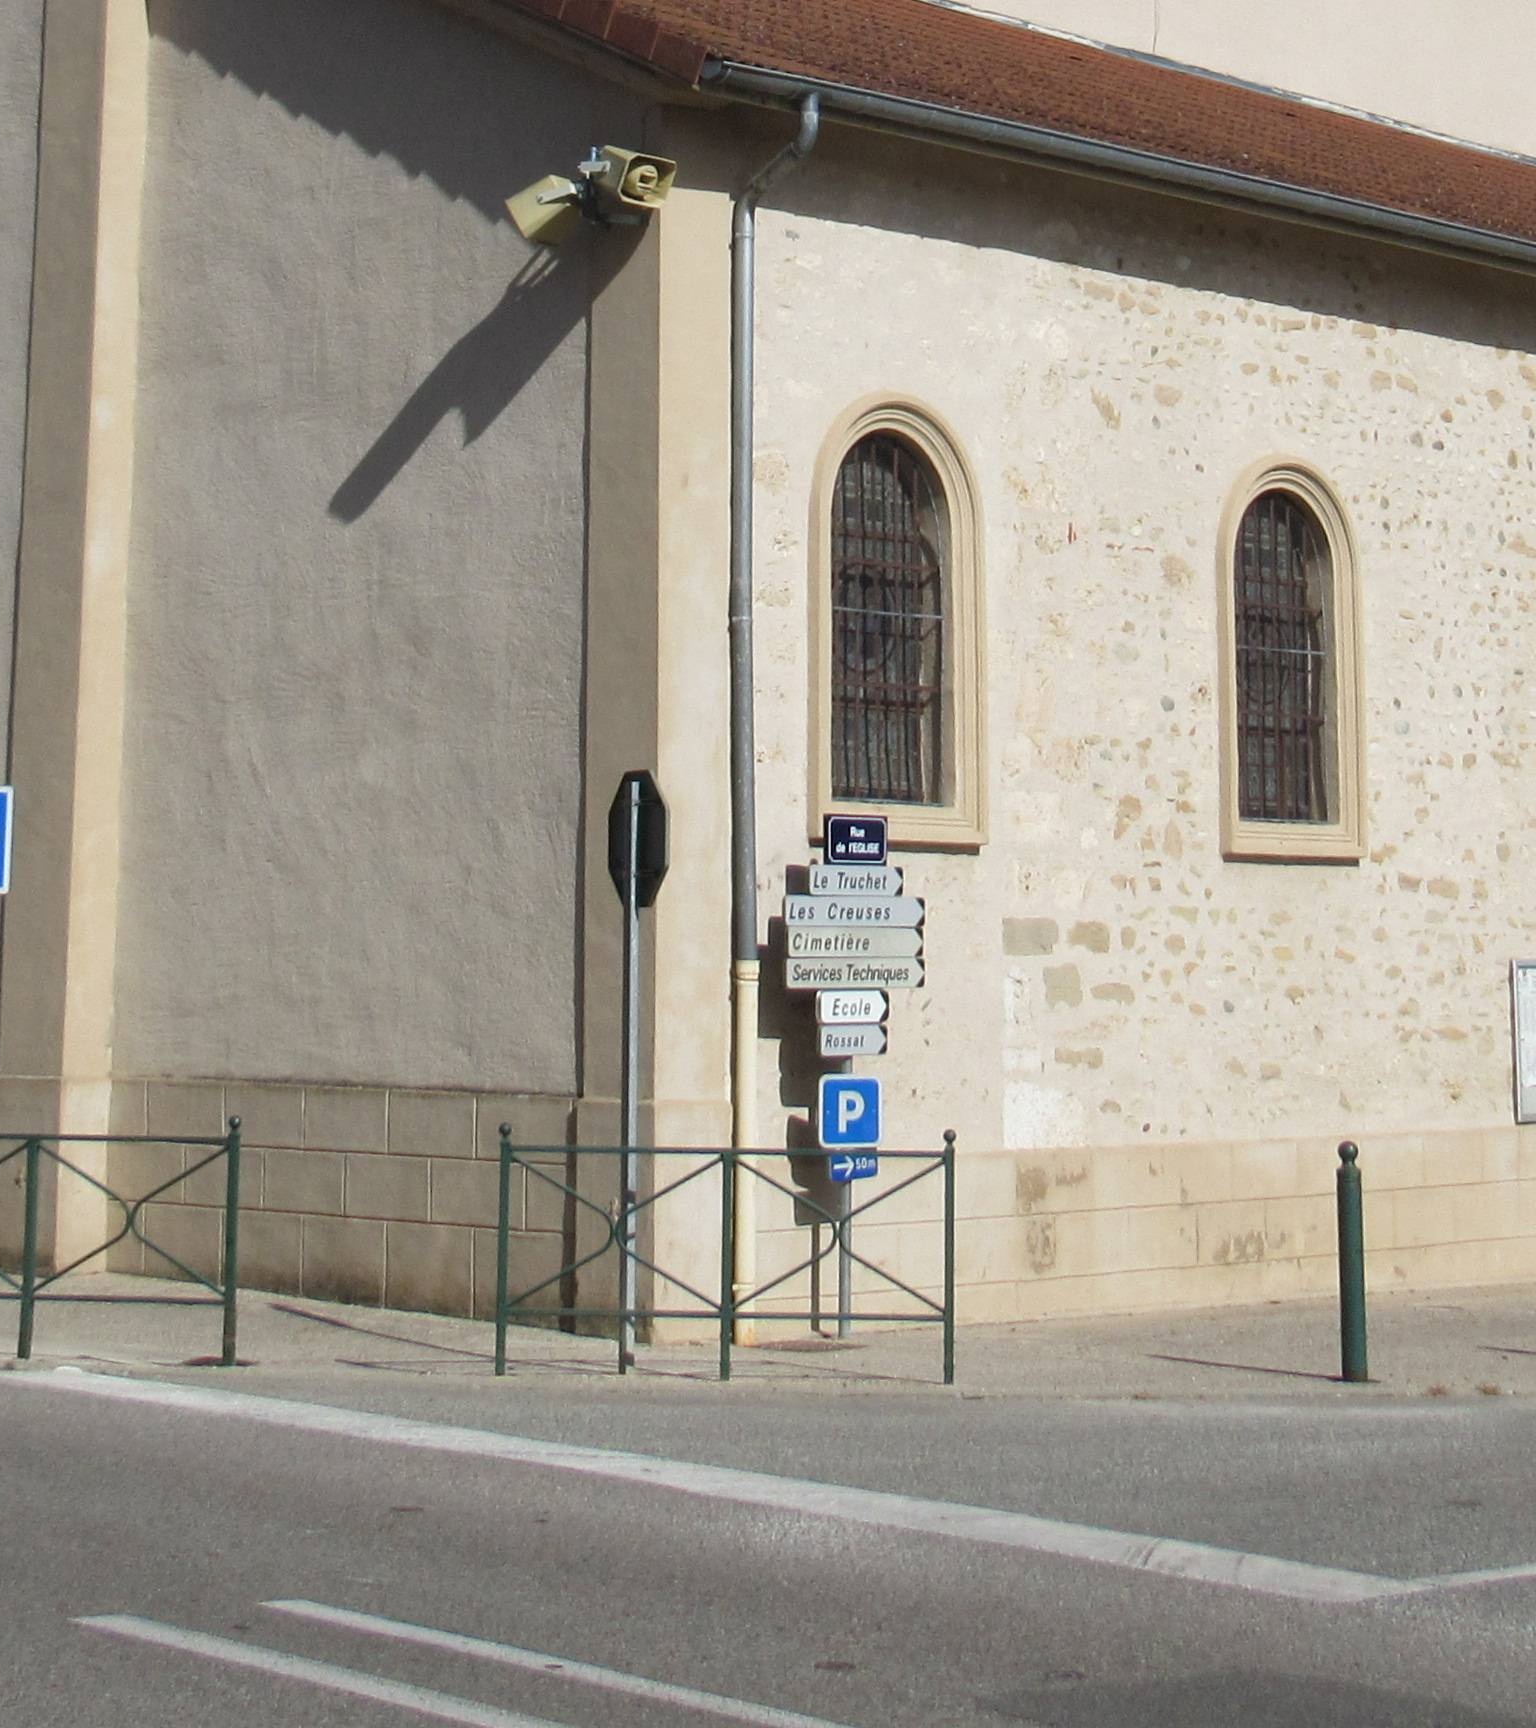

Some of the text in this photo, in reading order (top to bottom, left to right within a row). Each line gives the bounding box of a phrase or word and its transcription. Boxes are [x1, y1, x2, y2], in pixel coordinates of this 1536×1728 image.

[850, 826, 865, 838] Rue
[835, 841, 846, 853] de
[813, 871, 887, 889] Le Truchet
[789, 902, 891, 920] Les Creuses
[792, 932, 870, 951] Cimetière
[792, 963, 910, 986] Services Techniques
[831, 998, 872, 1017] Ecole
[825, 1034, 865, 1048] Rossat
[838, 1090, 865, 1134] P
